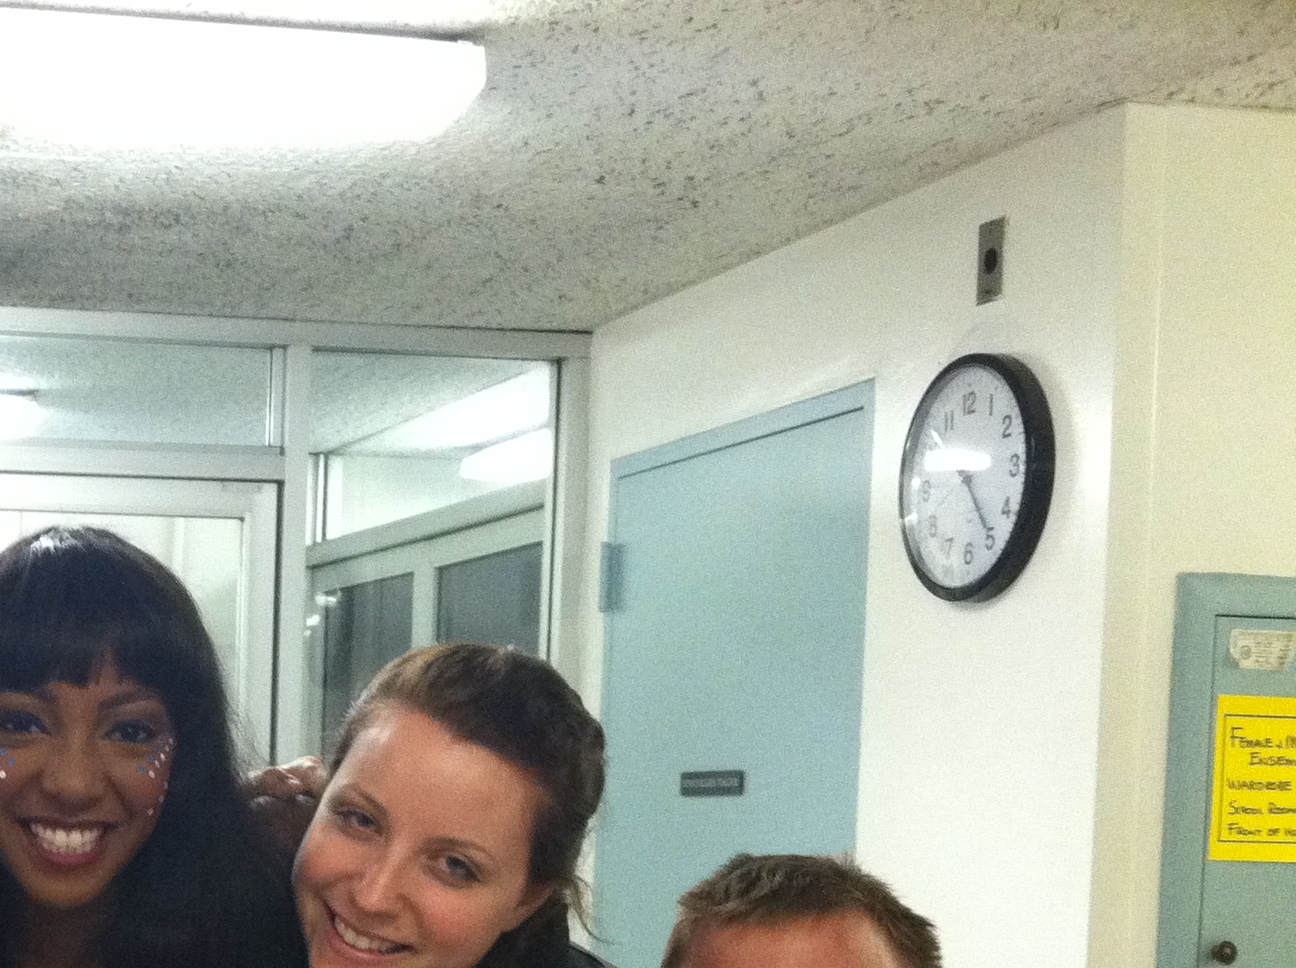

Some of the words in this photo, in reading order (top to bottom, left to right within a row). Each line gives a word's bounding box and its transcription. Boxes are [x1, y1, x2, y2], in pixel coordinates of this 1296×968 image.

[962, 390, 977, 416] 12
[988, 393, 994, 416] 1
[944, 410, 954, 432] 11
[1002, 414, 1013, 439] 2
[1009, 453, 1020, 478] 3
[921, 479, 931, 502] 9
[1001, 496, 1012, 519] 4
[928, 514, 938, 538] 8
[944, 537, 954, 560] 7
[985, 526, 996, 551] 5
[963, 542, 975, 565] 6
